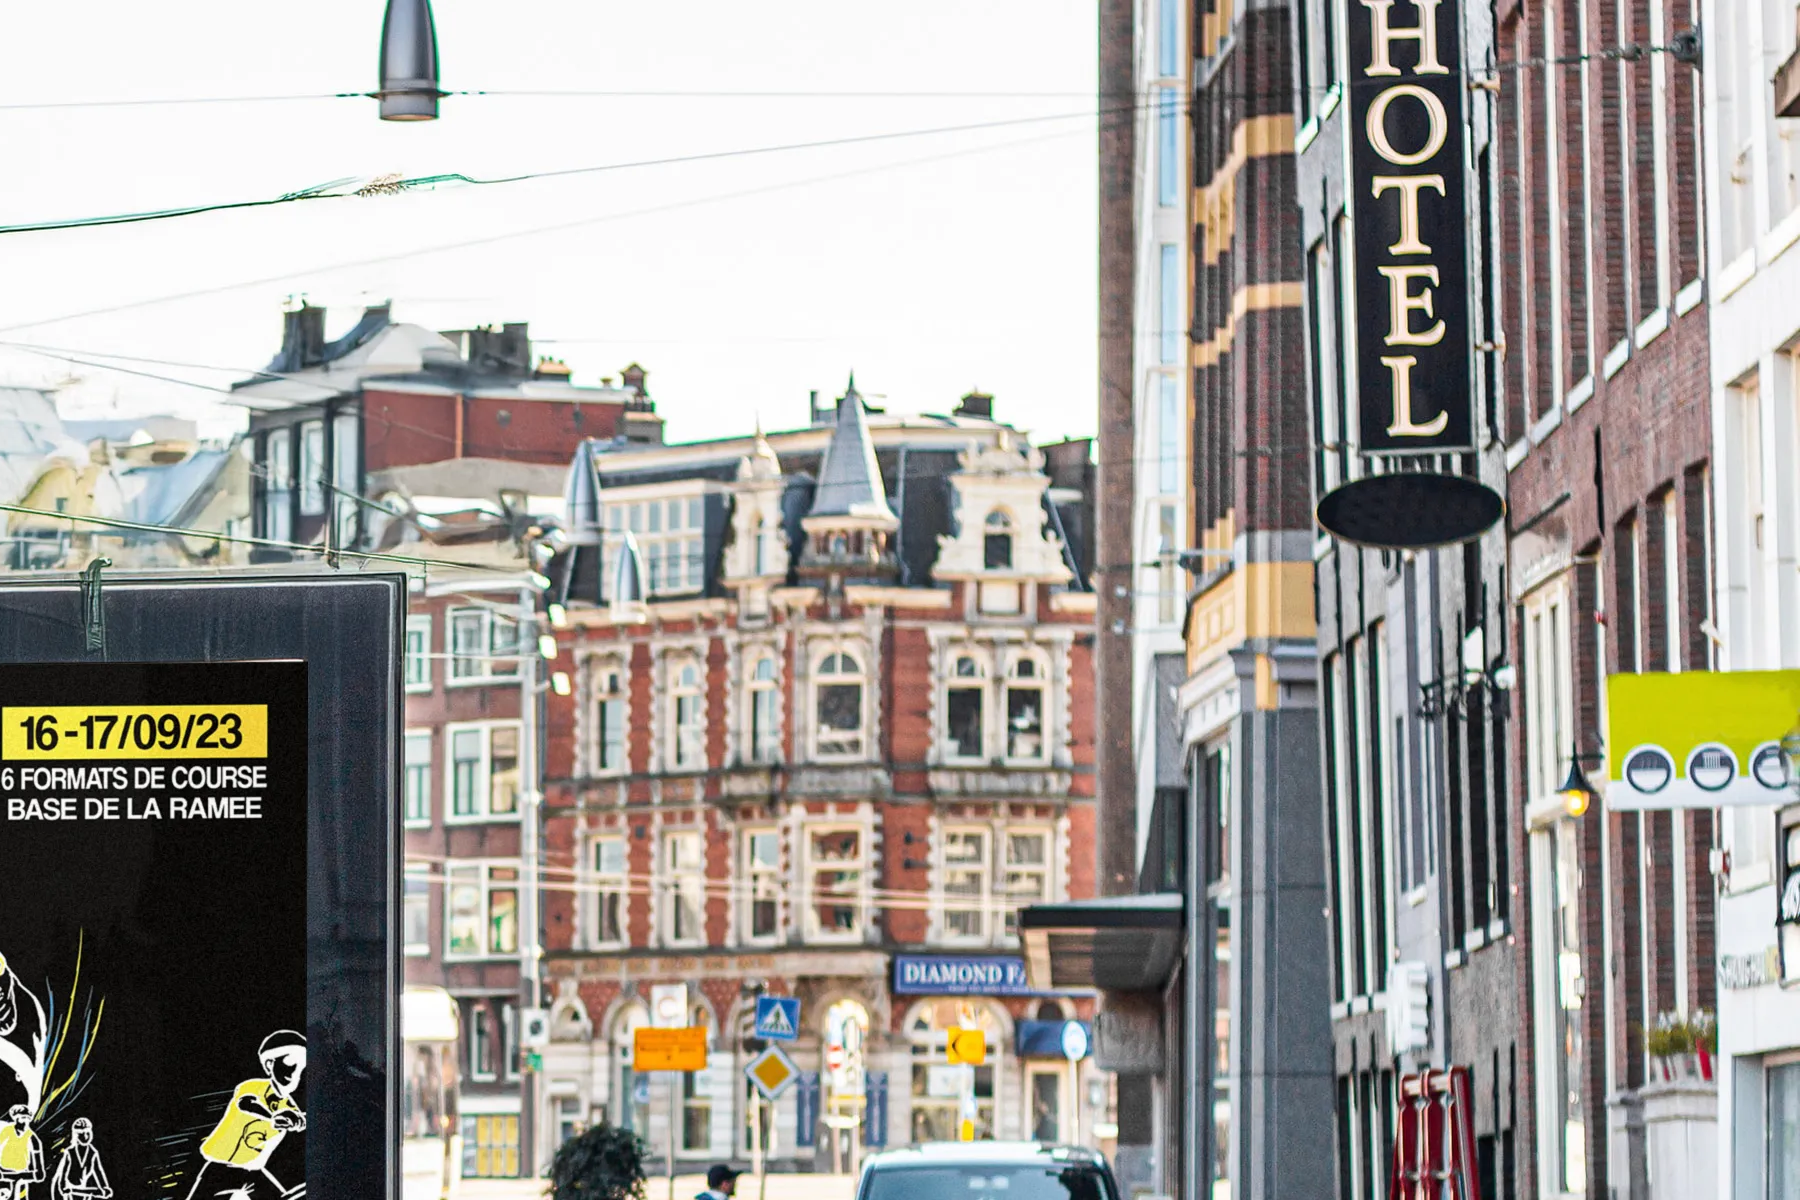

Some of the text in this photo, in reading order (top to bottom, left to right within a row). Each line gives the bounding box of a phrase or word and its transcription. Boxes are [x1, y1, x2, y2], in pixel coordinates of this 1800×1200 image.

[1361, 0, 1449, 437] HOTEL
[1, 766, 267, 790] 6 FORMATS DE COURSE
[8, 797, 262, 820] BASE DE LA RAMEE
[904, 963, 1002, 984] DIAMOND
